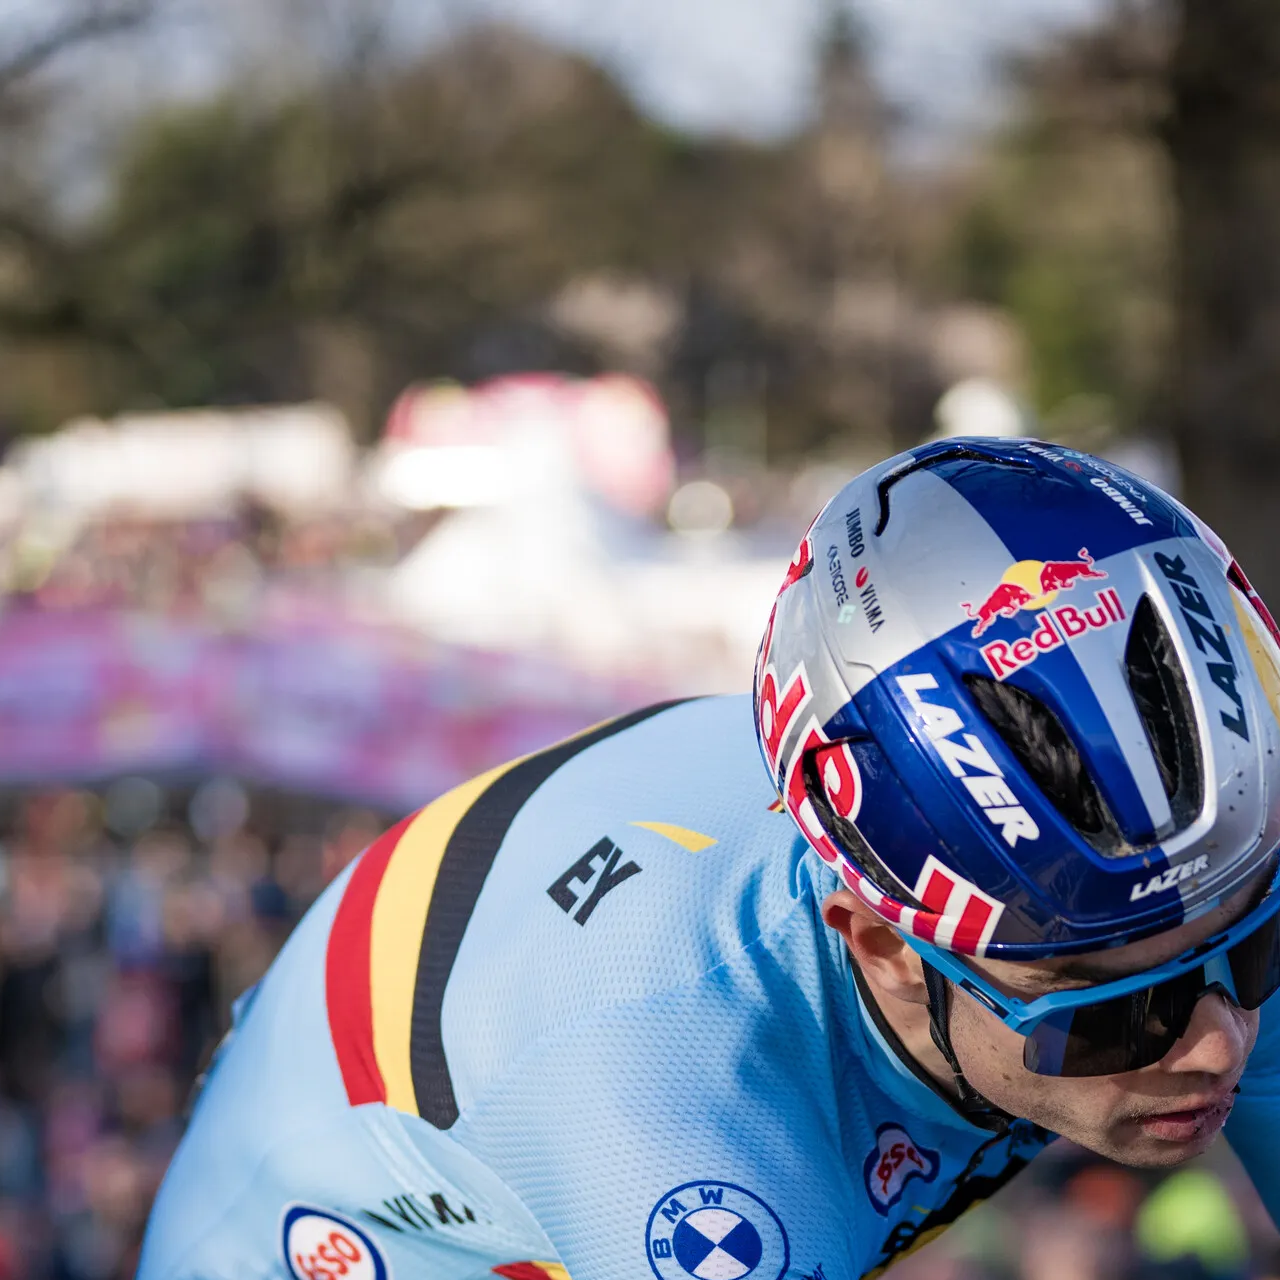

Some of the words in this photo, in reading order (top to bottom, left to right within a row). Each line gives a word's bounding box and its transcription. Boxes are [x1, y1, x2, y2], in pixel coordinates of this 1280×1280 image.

[1089, 477, 1153, 527] JUMBO
[846, 507, 866, 558] JUMBO
[859, 583, 886, 634] VISMA
[981, 624, 1061, 681] Red
[1056, 587, 1127, 646] Bull
[1154, 550, 1250, 743] LAZER
[895, 672, 1040, 848] LAZER
[546, 835, 643, 927] EY
[1129, 852, 1209, 903] LAZER
